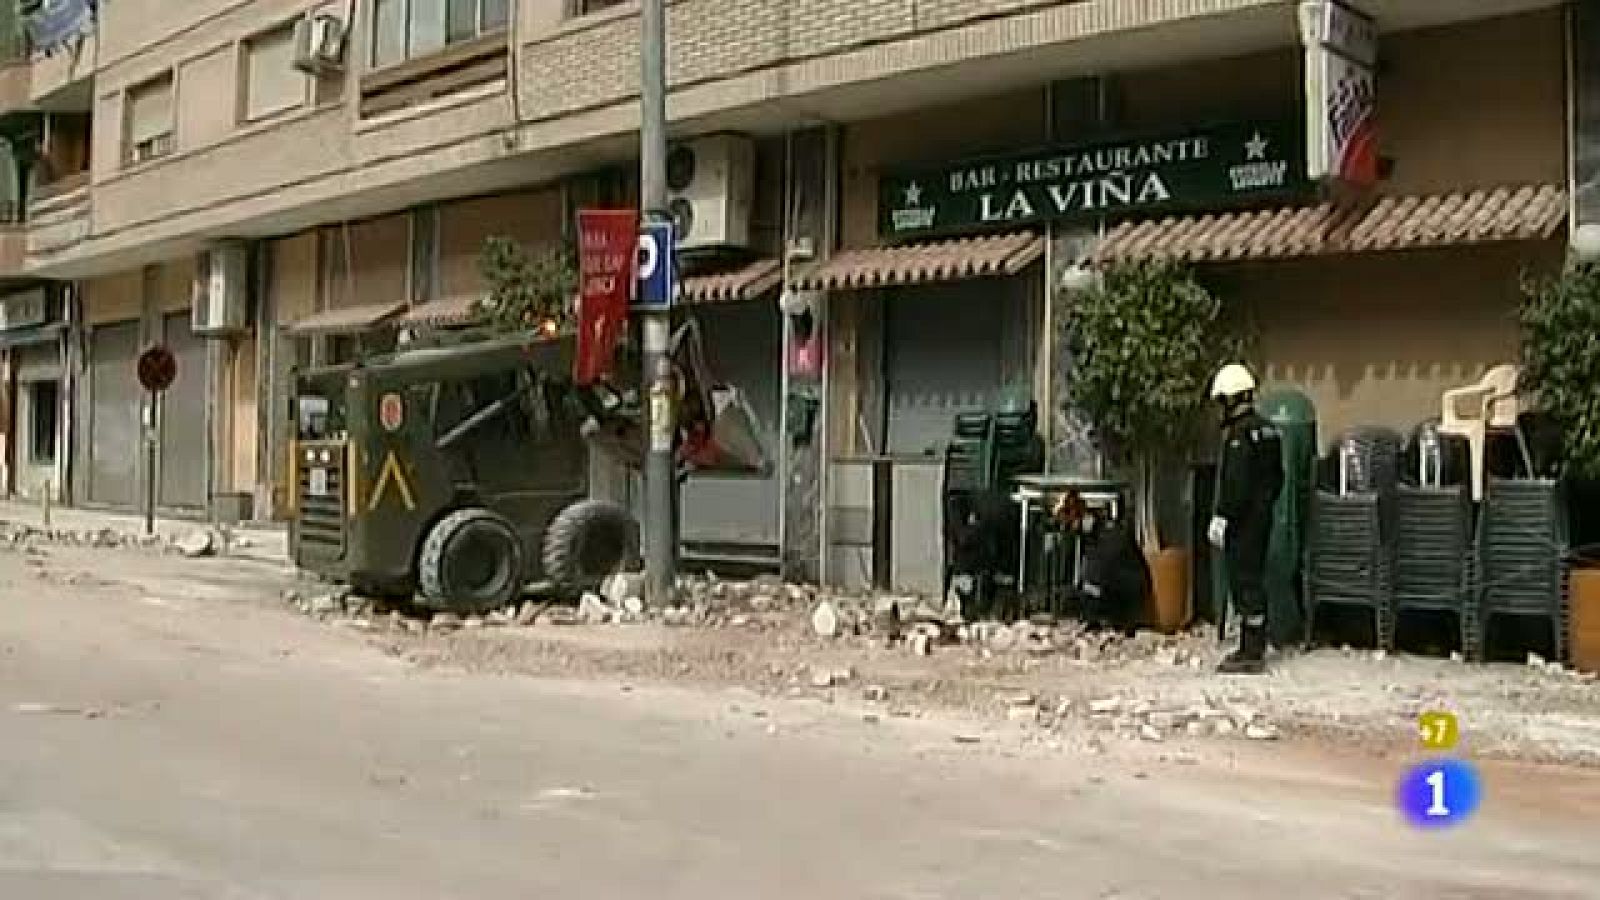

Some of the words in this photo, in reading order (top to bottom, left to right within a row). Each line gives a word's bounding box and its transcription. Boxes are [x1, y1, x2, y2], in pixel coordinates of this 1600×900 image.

[949, 166, 996, 192] BAR
[1015, 137, 1209, 182] RESTAURANTE
[980, 187, 1036, 221] LA
[1045, 169, 1171, 214] VIÑA
[630, 233, 659, 301] P
